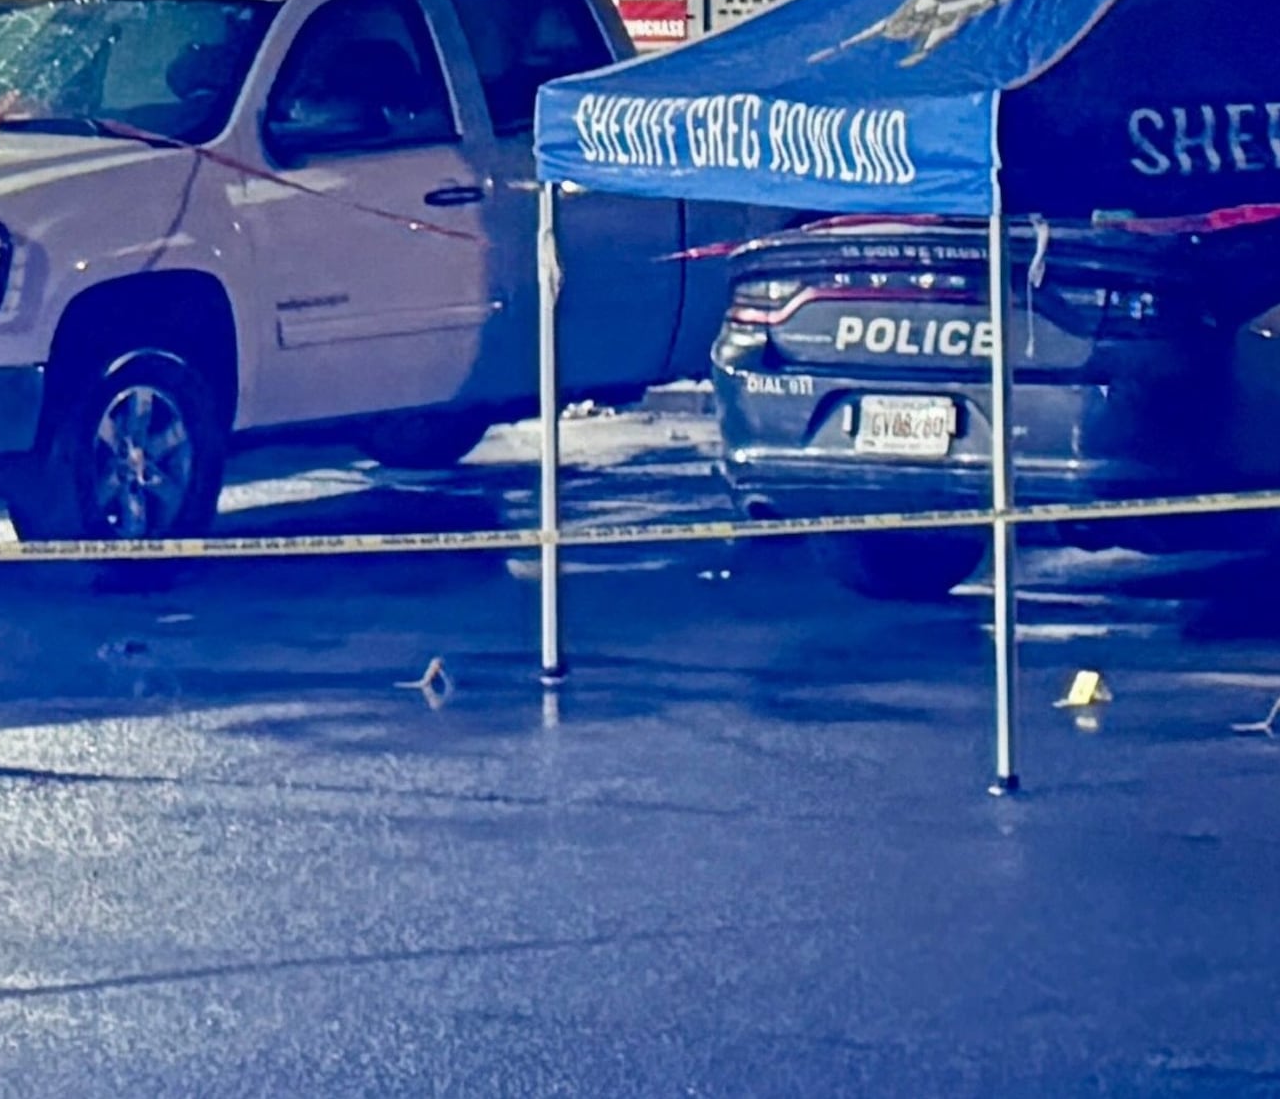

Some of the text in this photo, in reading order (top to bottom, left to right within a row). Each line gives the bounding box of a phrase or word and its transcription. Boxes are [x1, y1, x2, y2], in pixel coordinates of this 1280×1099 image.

[575, 93, 916, 184] SHERIFF GREG ROWLAND
[834, 315, 994, 357] POLICE
[747, 375, 814, 395] DIAL 911
